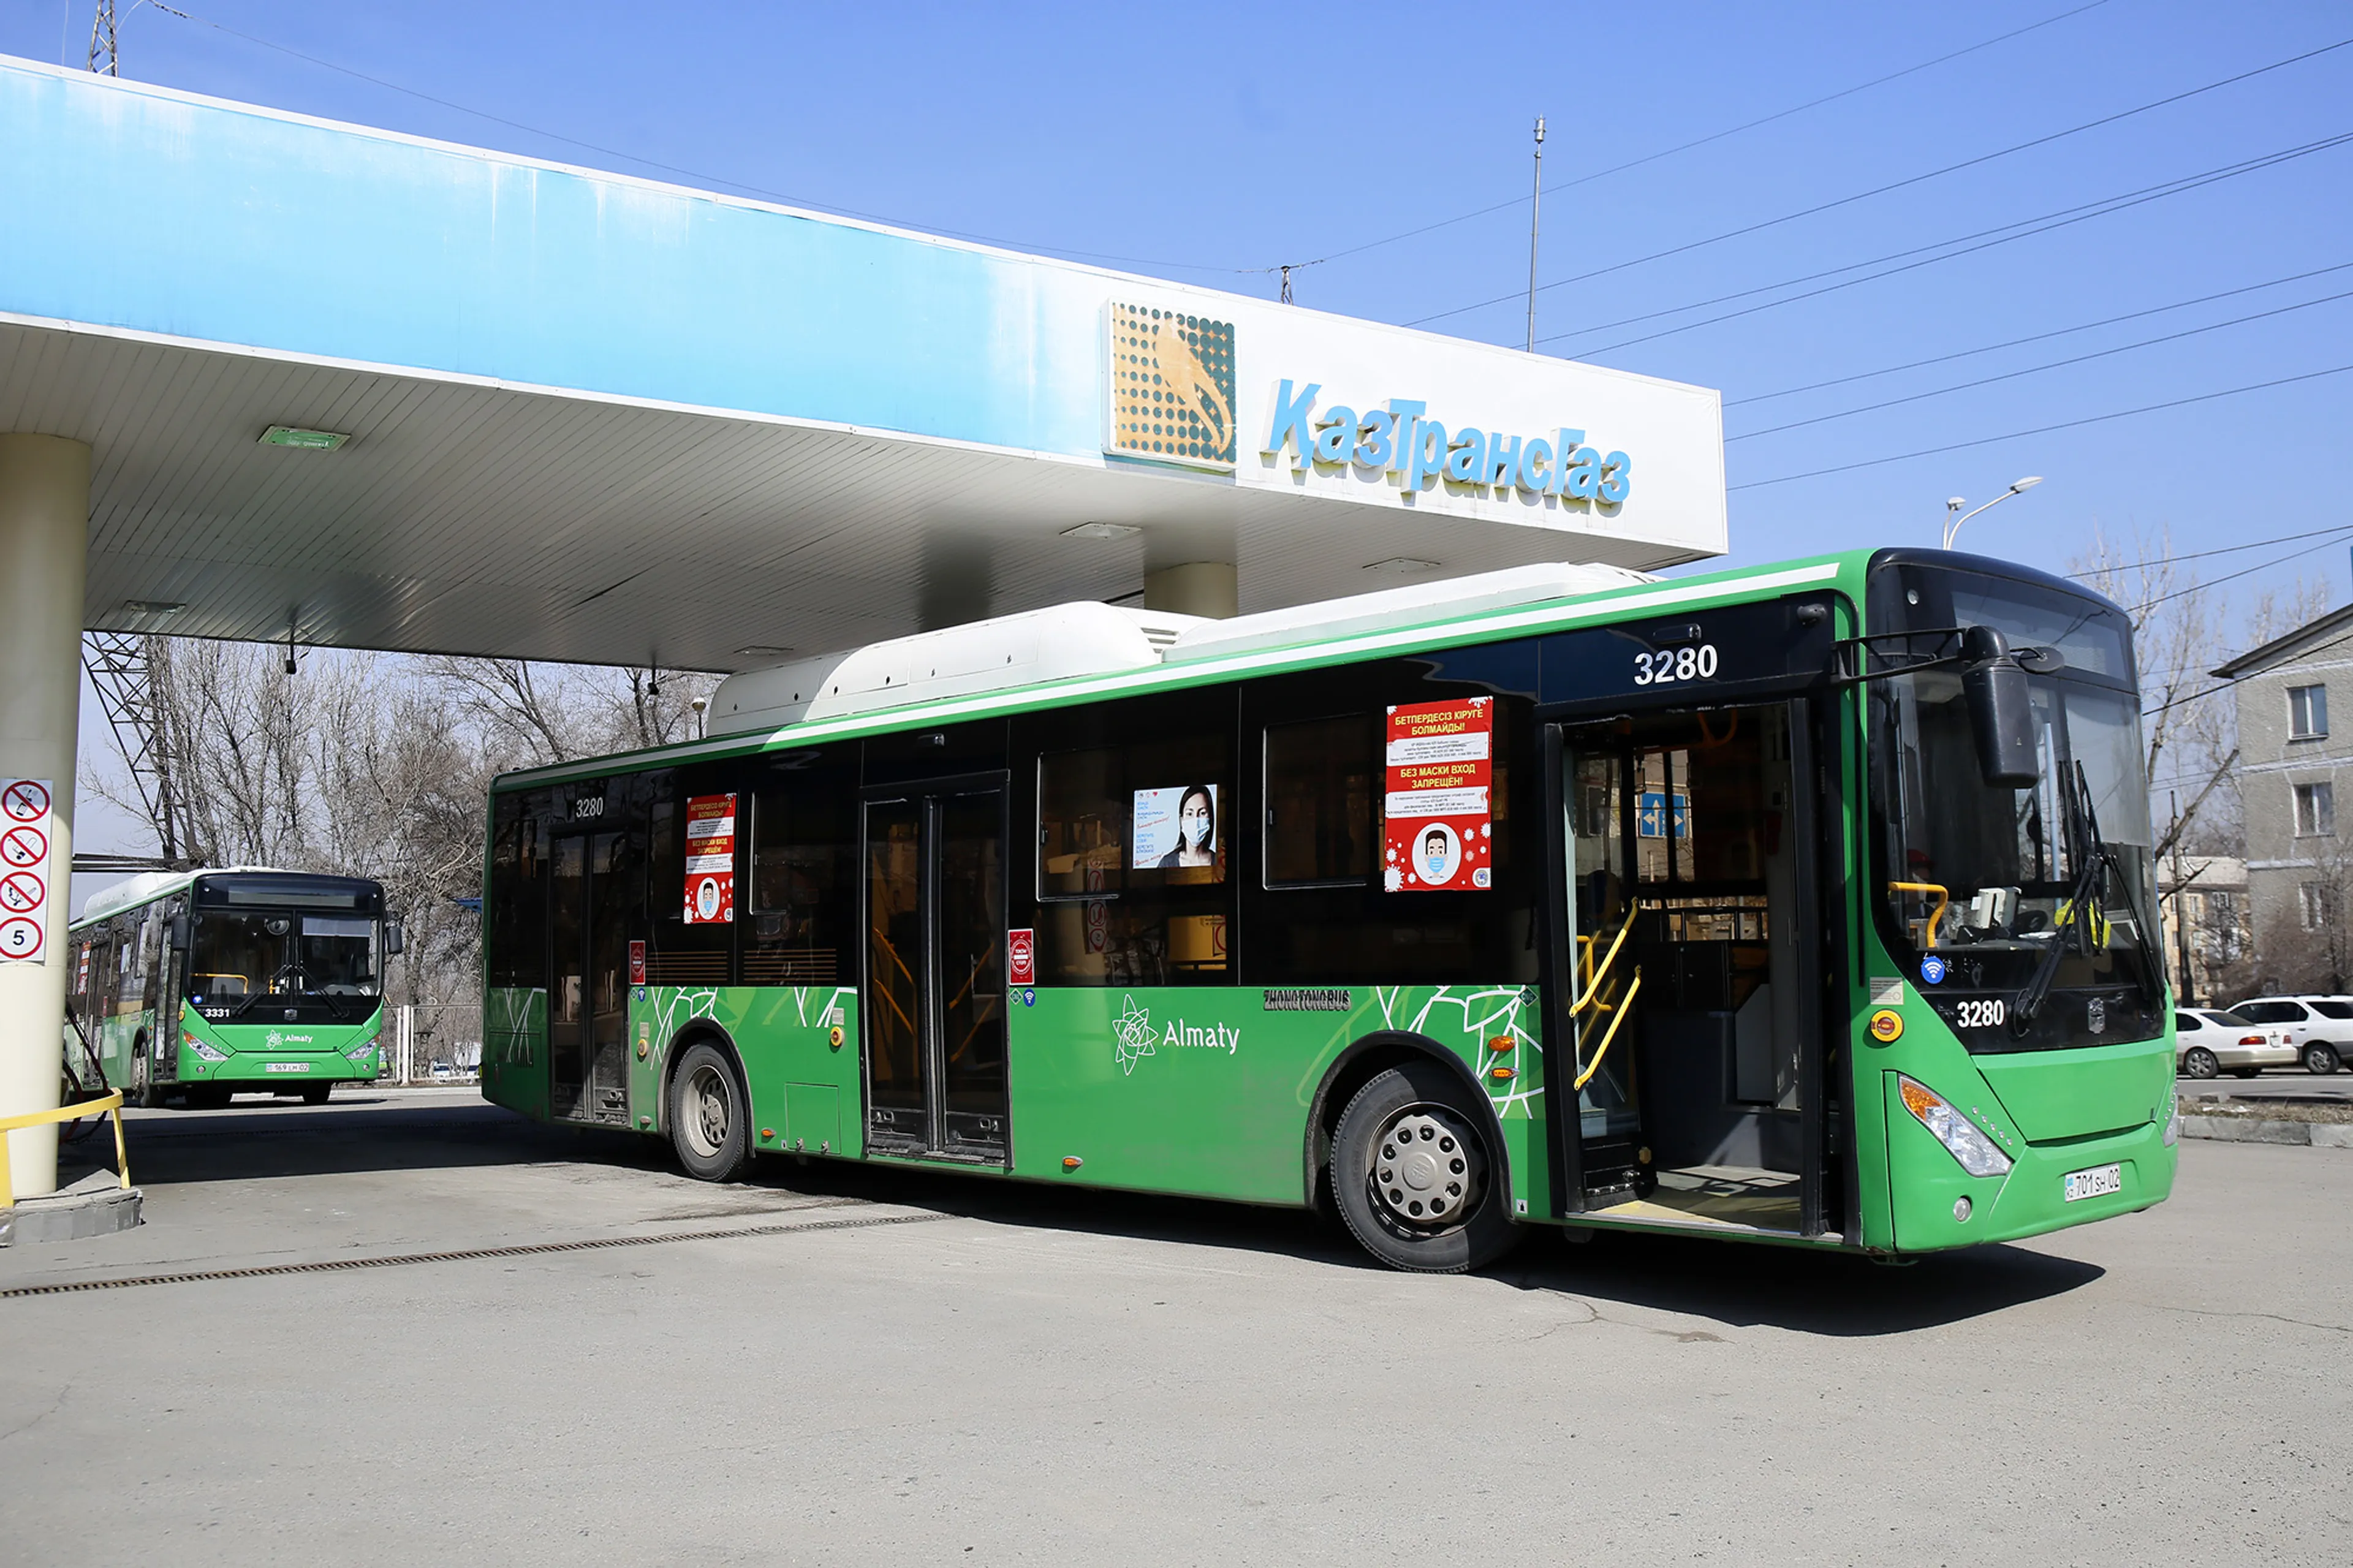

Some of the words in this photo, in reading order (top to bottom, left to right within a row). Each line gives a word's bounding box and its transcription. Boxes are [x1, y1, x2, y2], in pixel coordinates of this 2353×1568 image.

[1634, 645, 1718, 686] 3280
[1395, 711, 1452, 725] БЕТПЕРДЕСІЗ
[1454, 708, 1483, 720] КІРУГЕ
[1411, 722, 1465, 735] БОЛМАЙДЫ!
[1400, 768, 1417, 778] БЕЗ
[1419, 765, 1449, 776] МАСКИ
[1451, 763, 1476, 775] ВХОД
[1411, 775, 1463, 789] ЗАПРЕЩЁН!
[577, 797, 603, 817] 3280
[13, 930, 25, 945] 5
[205, 1008, 230, 1017] 3331
[1957, 999, 2004, 1028] 3280
[285, 1034, 313, 1043] Almaty
[1162, 1018, 1240, 1055] Almaty
[2076, 1173, 2093, 1196] 701
[2096, 1175, 2105, 1192] SH
[2109, 1168, 2119, 1188] 02
